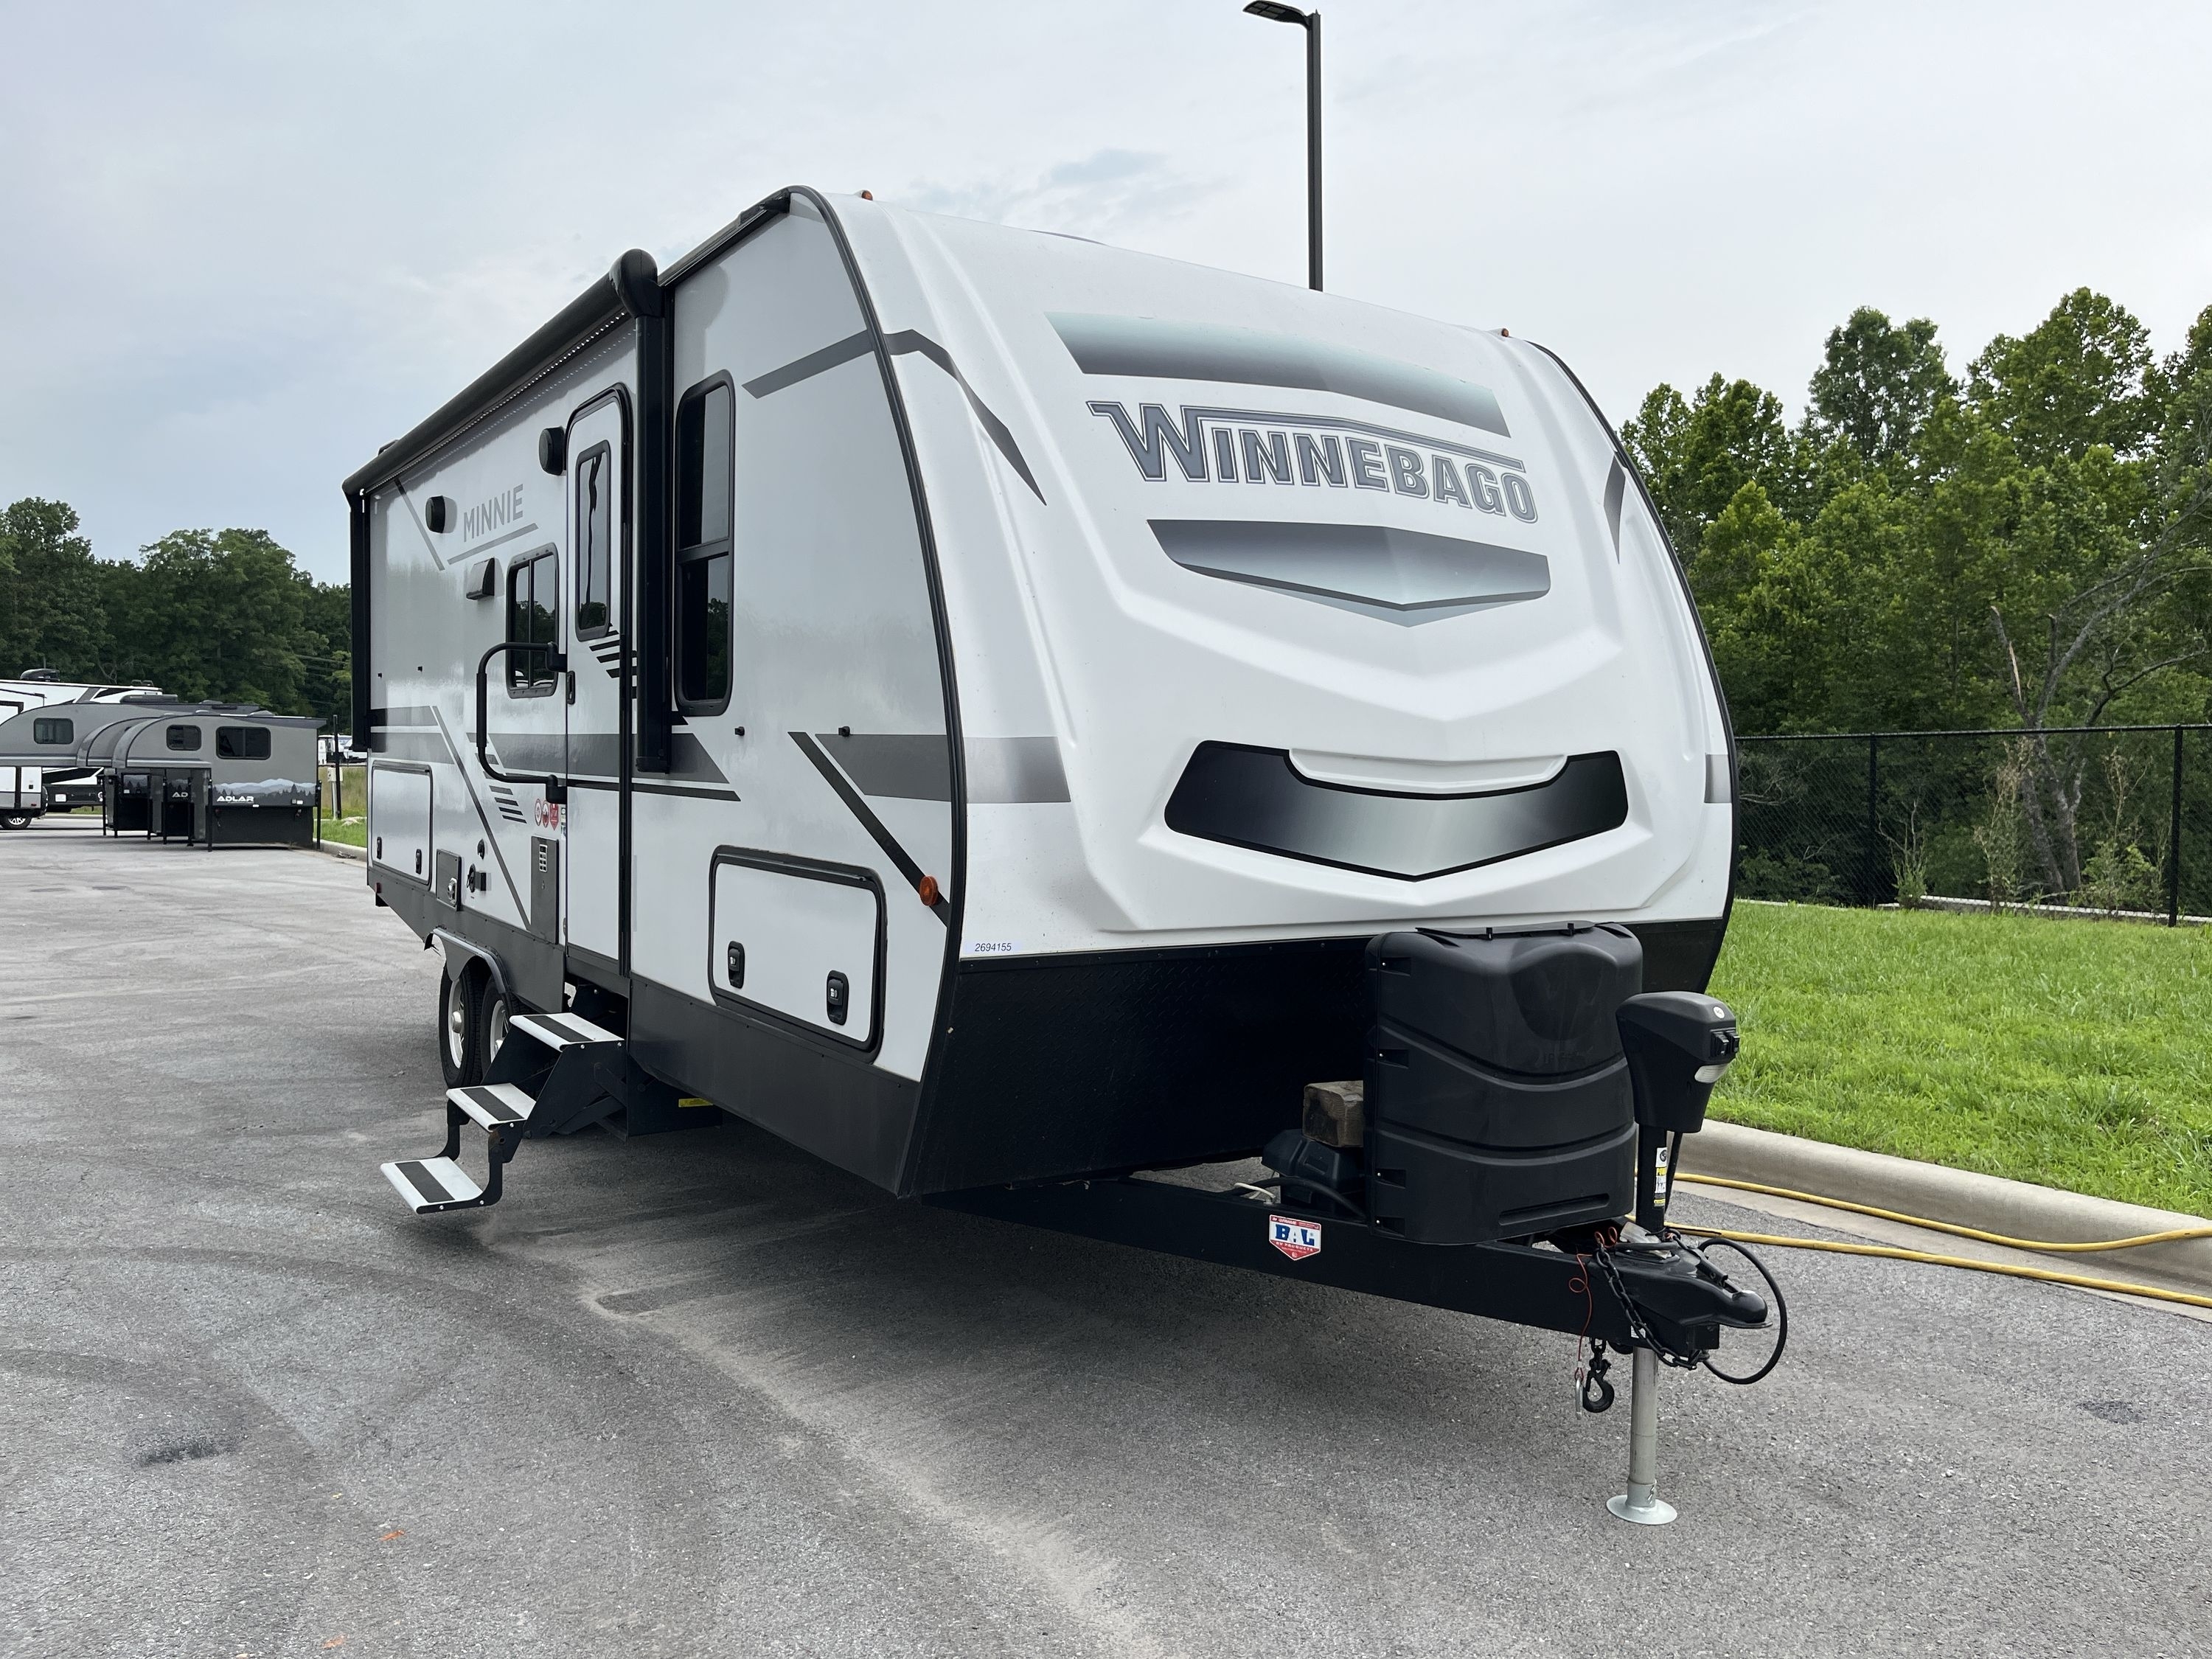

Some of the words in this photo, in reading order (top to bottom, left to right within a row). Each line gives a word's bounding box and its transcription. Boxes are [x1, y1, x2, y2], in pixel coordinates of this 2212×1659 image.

[1086, 400, 1539, 524] WINNEBAGO
[464, 484, 523, 542] MINNIE
[975, 942, 1012, 952] 2694155
[1275, 1224, 1315, 1246] BAL
[1284, 1242, 1314, 1252] PRODUCTS
